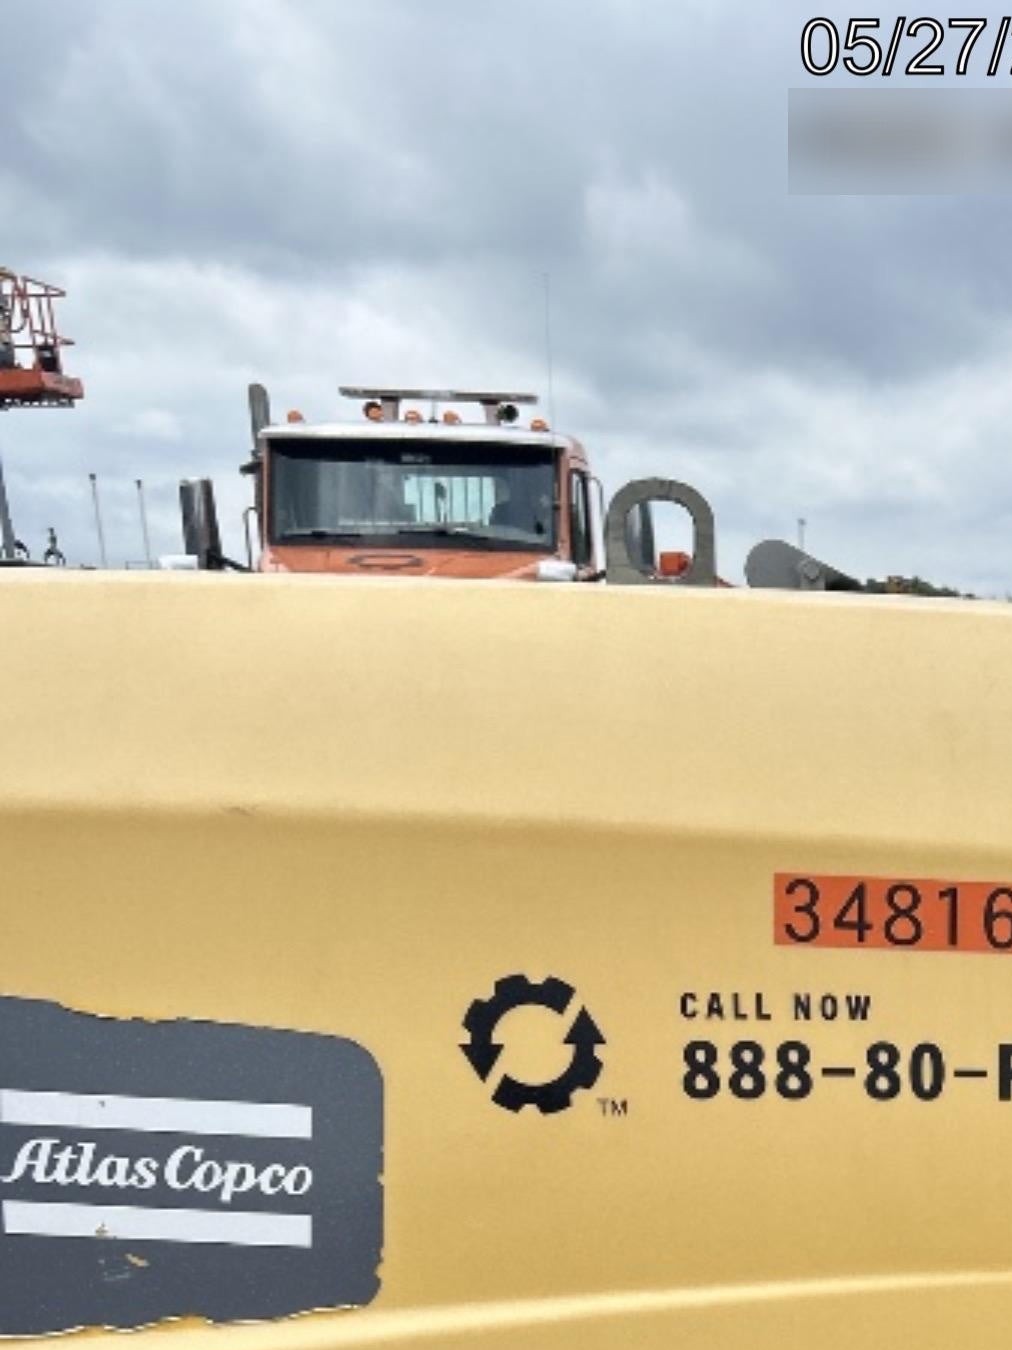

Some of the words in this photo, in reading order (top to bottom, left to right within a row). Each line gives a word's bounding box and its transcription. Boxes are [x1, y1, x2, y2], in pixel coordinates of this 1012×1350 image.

[680, 992, 771, 1020] CALL
[794, 994, 873, 1022] NOW
[598, 1100, 629, 1116] TM
